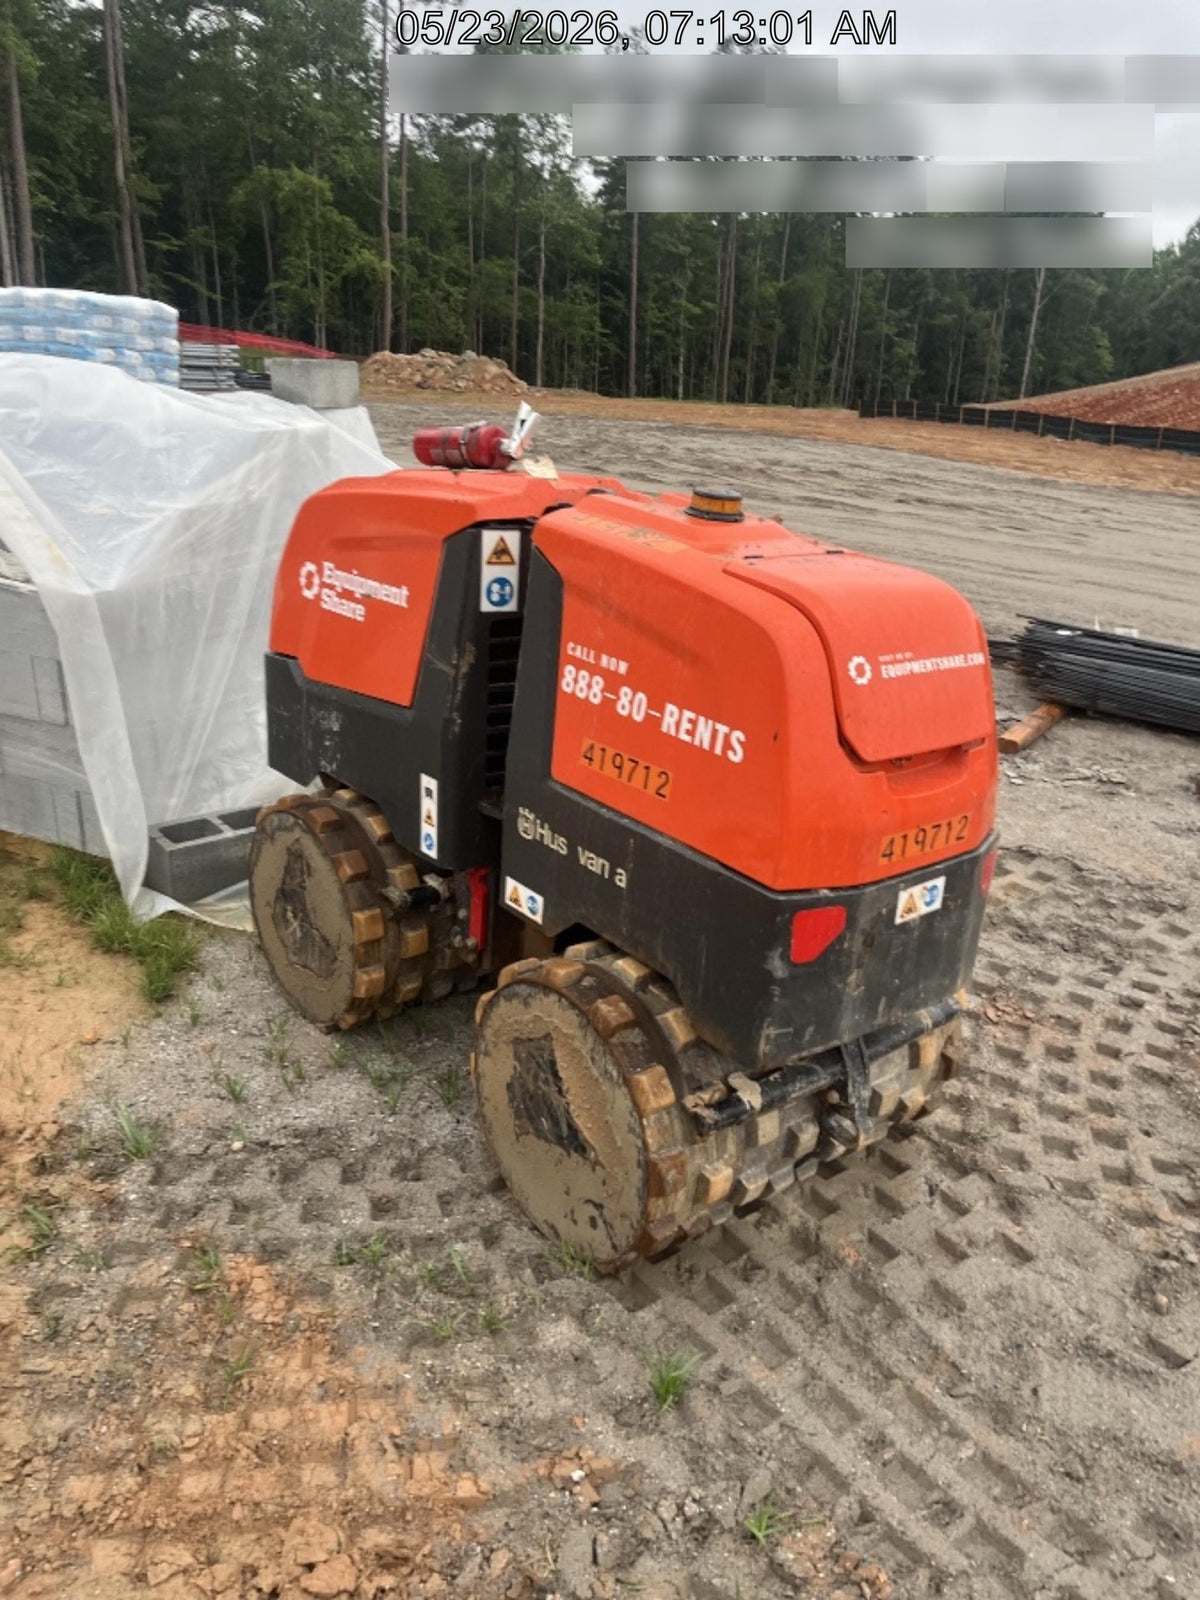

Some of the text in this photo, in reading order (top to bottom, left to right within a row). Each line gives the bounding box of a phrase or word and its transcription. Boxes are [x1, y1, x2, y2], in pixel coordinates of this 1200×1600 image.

[321, 588, 365, 622] Share
[322, 560, 409, 608] Equipment
[567, 641, 630, 675] CALL NOW
[561, 664, 746, 763] 888-80-RENTS
[583, 743, 670, 799] 419712
[881, 815, 968, 862] 419712
